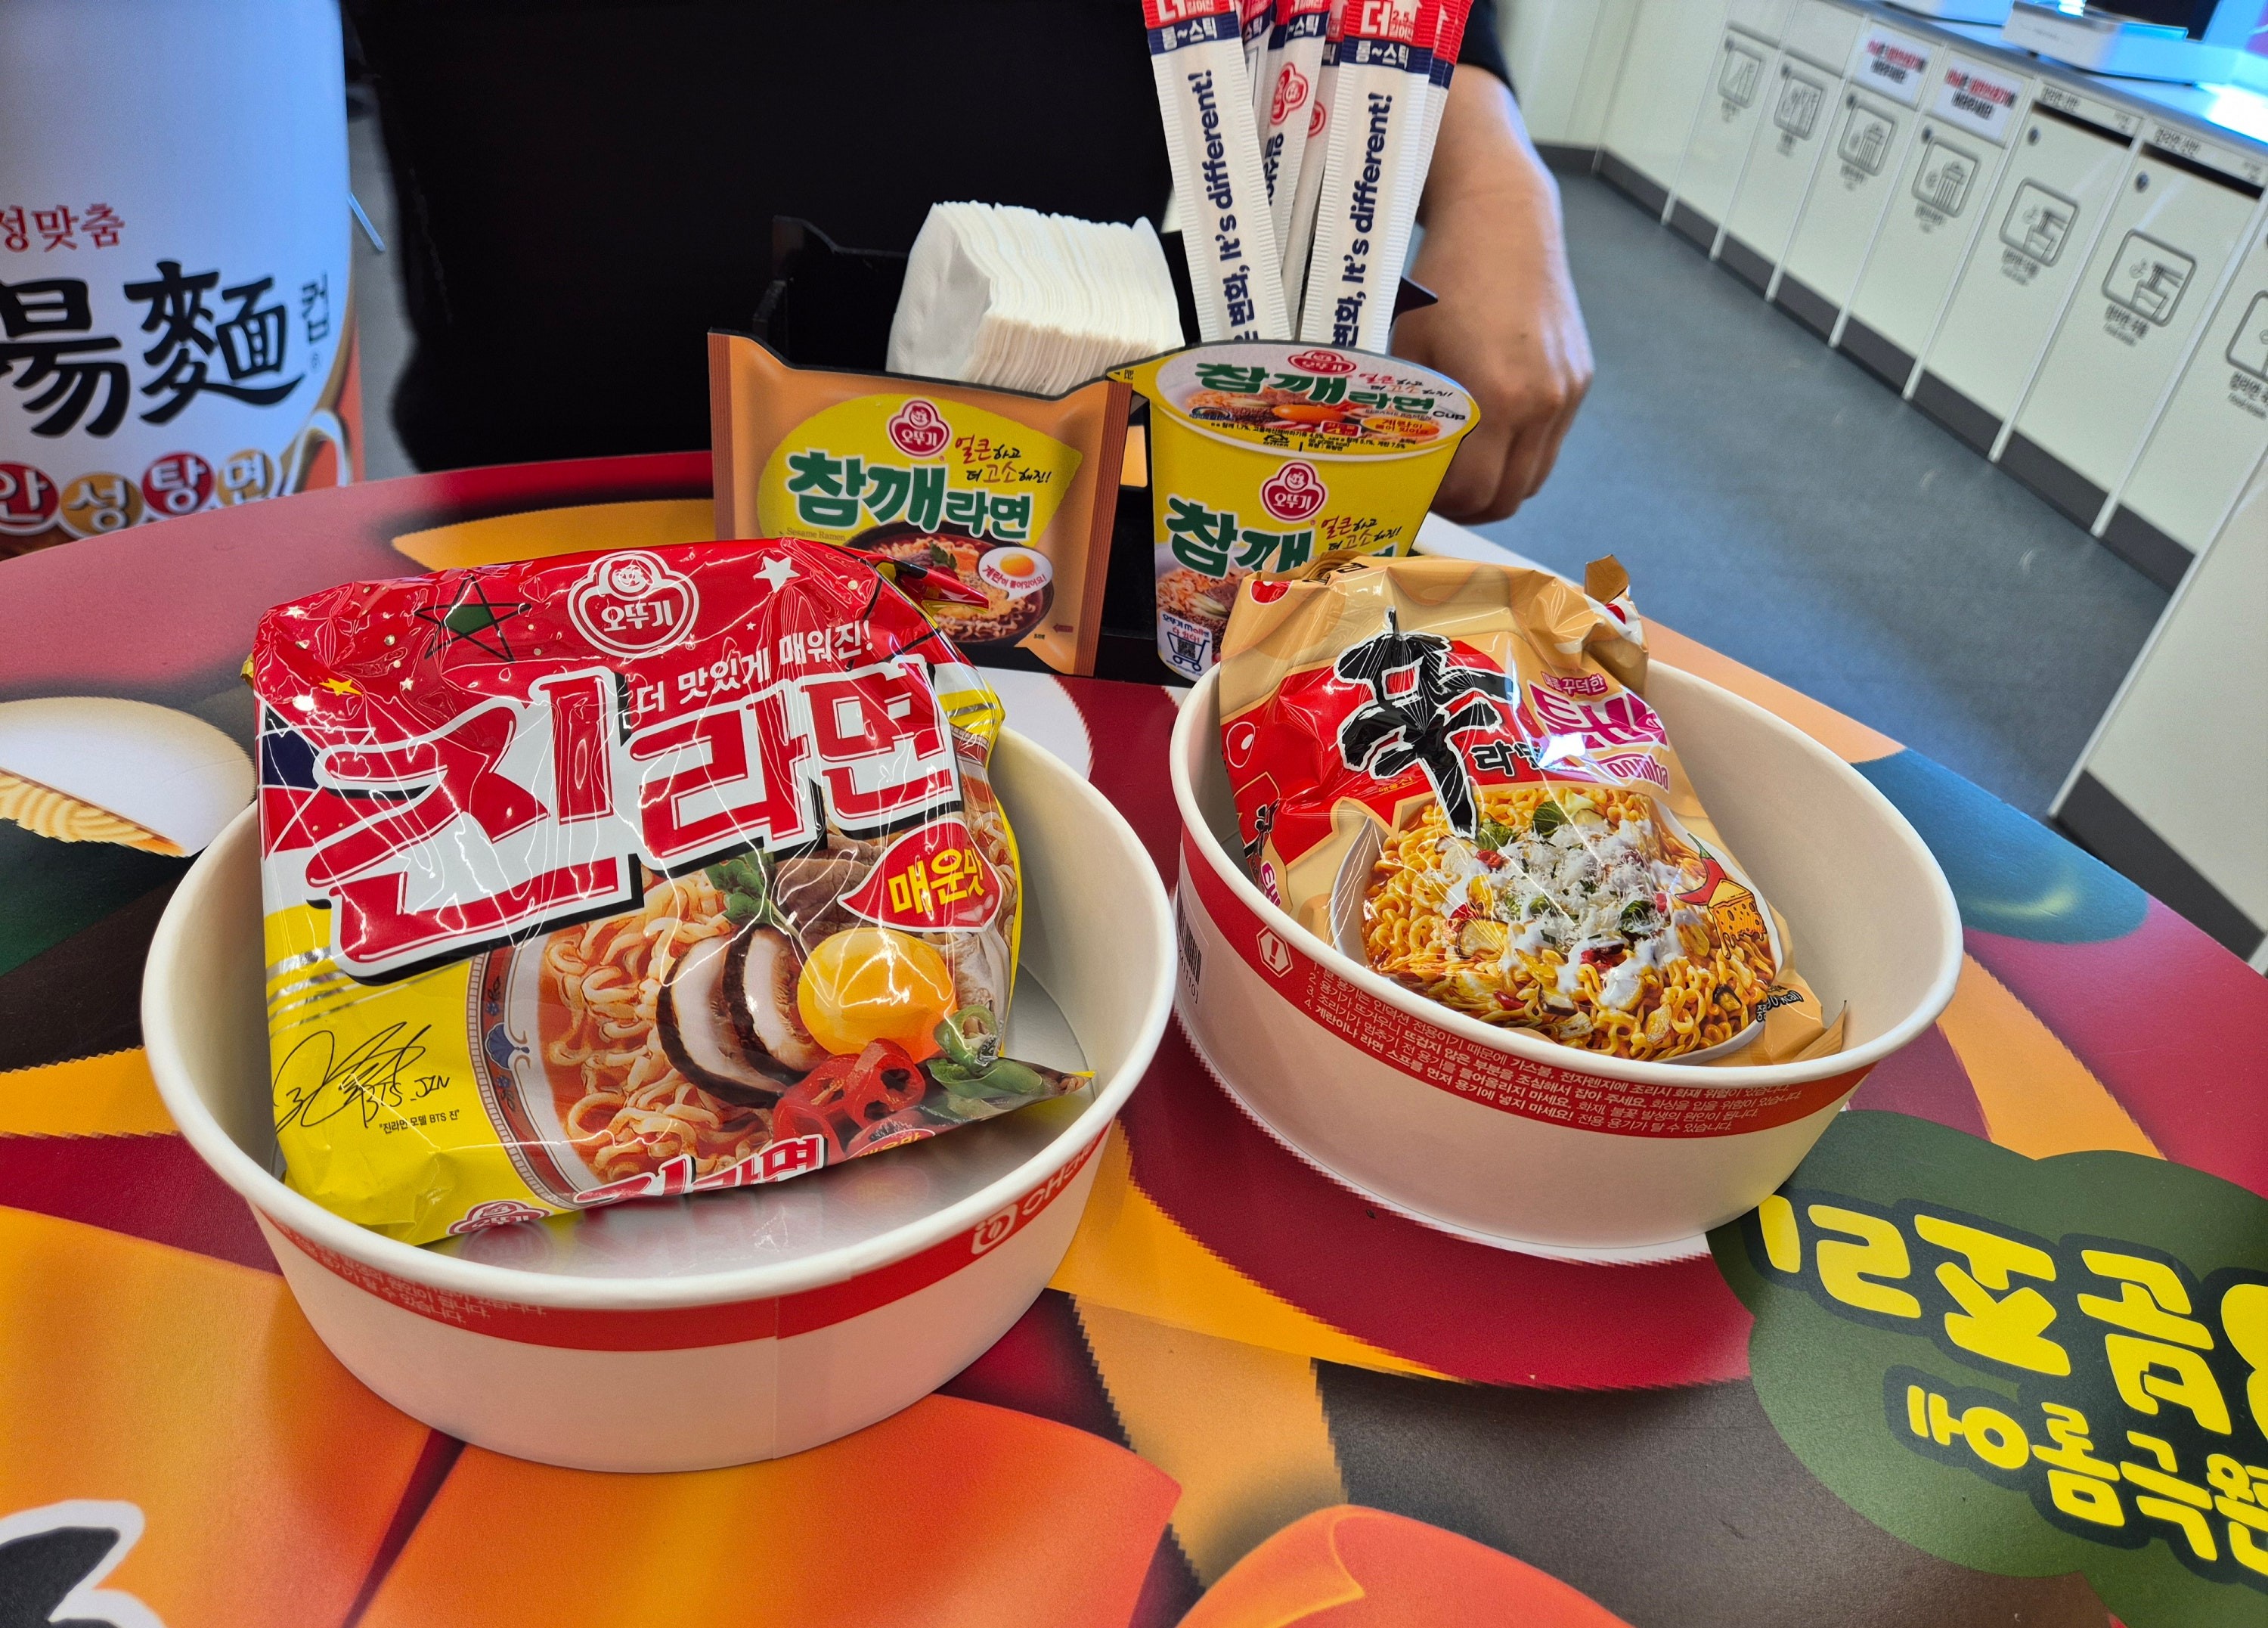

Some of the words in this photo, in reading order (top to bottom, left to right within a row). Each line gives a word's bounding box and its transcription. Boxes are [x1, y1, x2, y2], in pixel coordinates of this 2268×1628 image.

[1361, 1, 1392, 36] 더
[1188, 69, 1234, 210] different!
[1349, 92, 1393, 231] different!
[1215, 213, 1242, 261] It's
[1342, 237, 1369, 284] It's
[1194, 362, 1435, 414] 참깨라면
[901, 429, 937, 447] 오뚜기
[955, 434, 1021, 464] 얼큰하고
[788, 450, 1030, 539] 참깨라면
[966, 469, 983, 482] 더
[1274, 492, 1312, 510] 오뚜기
[1321, 515, 1377, 540] 얼큰하고
[600, 600, 673, 631] 오뚜기
[636, 684, 665, 713] 더
[677, 647, 771, 705] 맛있게
[779, 620, 873, 666] 매워진!
[1562, 673, 1606, 695] 꾸덕한
[888, 848, 985, 915] 매운맛
[1317, 993, 1362, 1027] 조리기가
[1364, 1022, 1399, 1048] 멈추기
[1402, 1042, 1415, 1056] 전
[1418, 1050, 1456, 1074] 용기를
[1459, 1067, 1526, 1097] 들어올리지
[1320, 980, 1352, 1008] 용기가
[1353, 1003, 1401, 1036] 뜨거우니
[1402, 1030, 1442, 1054] 뜨겁지
[1445, 1047, 1470, 1066] 않은
[1473, 1059, 1514, 1081] 부분을
[1516, 1074, 1571, 1096] 조심해서
[1374, 1000, 1410, 1026] 인덕션
[1413, 1019, 1464, 1050] 전용이기
[1467, 1043, 1507, 1065] 때문에
[1630, 1084, 1672, 1096] 조리시
[1315, 1005, 1359, 1038] 계란이나
[1360, 1034, 1383, 1053] 라면
[1385, 1050, 1424, 1073] 스프를
[1427, 1067, 1452, 1086] 먼저
[1455, 1079, 1496, 1101] 용기에
[1498, 1093, 1526, 1110] 넣지
[1528, 1102, 1574, 1121] 마세요!
[1577, 1114, 1605, 1127] 전용
[1607, 1118, 1649, 1131] 용기가
[1666, 1123, 1680, 1133] 수
[410, 1115, 427, 1126] 모델
[429, 1112, 447, 1123] BTS
[1758, 1195, 2071, 1376] 조리
[1907, 1385, 2125, 1527] 물에
